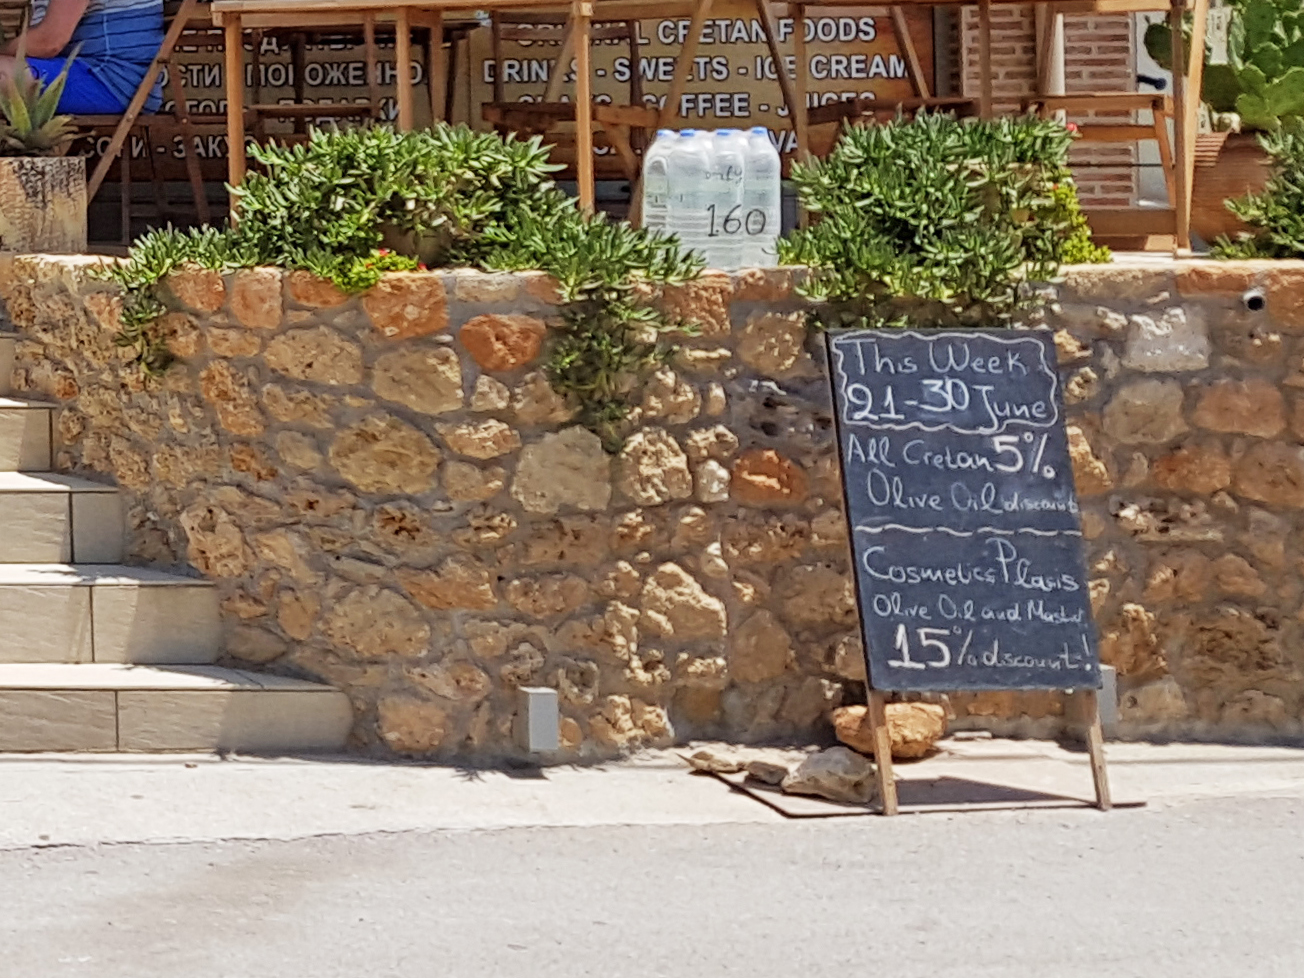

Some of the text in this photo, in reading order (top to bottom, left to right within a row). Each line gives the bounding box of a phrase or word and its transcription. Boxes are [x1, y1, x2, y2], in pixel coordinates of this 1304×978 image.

[483, 58, 582, 83] DRINS
[613, 56, 729, 83] SWETS
[810, 54, 910, 79] CREAM
[838, 338, 1029, 376] This Week
[973, 385, 1047, 431] June
[847, 433, 896, 468] All
[902, 439, 994, 471] Cretan
[867, 468, 944, 511] Olive
[950, 481, 1004, 514] Oil
[862, 545, 996, 586] Cosmetics
[873, 592, 932, 621] Olive
[938, 593, 977, 622] Oil
[980, 602, 1022, 622] and
[888, 623, 978, 670] 15%
